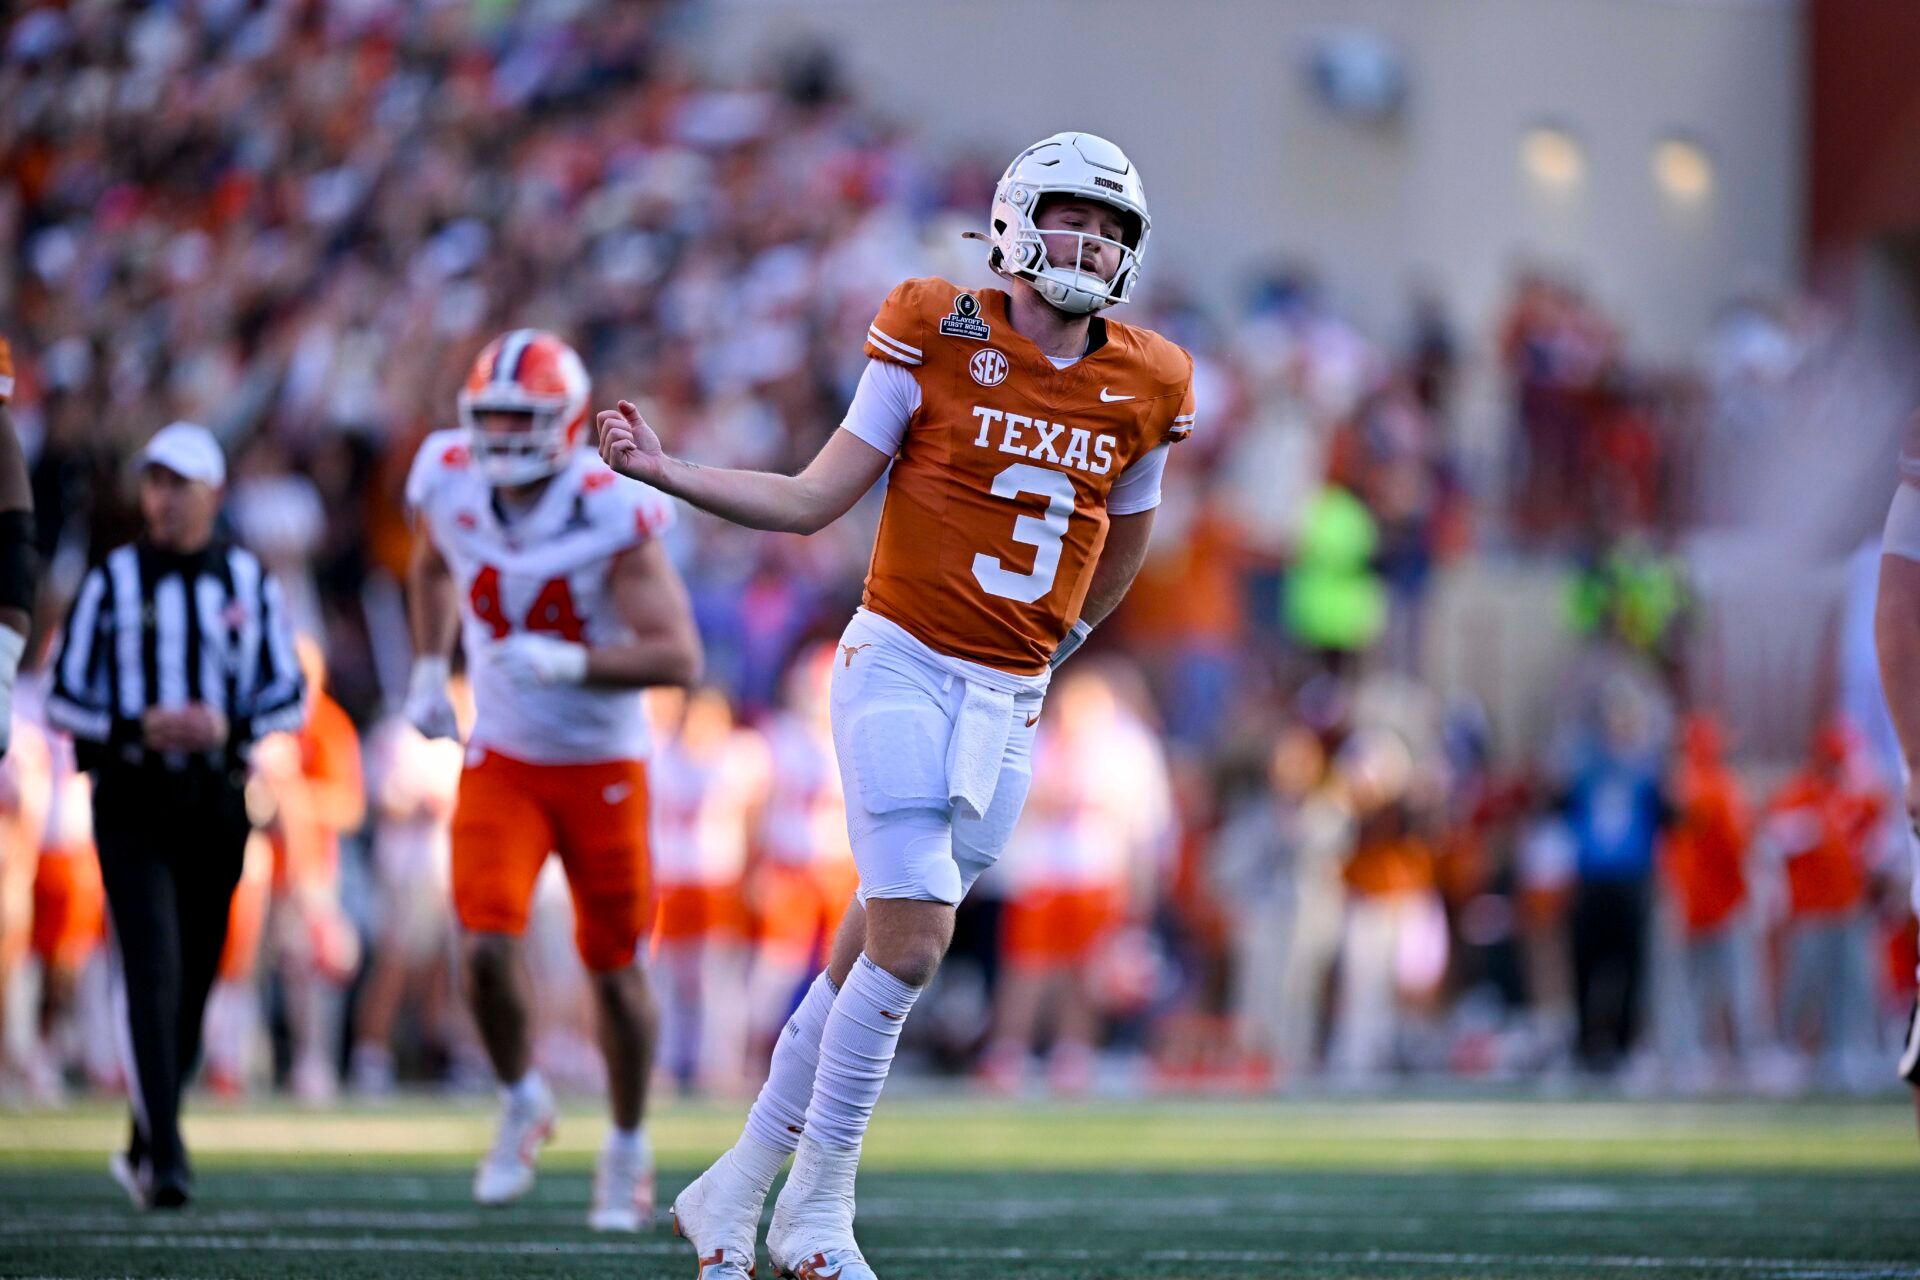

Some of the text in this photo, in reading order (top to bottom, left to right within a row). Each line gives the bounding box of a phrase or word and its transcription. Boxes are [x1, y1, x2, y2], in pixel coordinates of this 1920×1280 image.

[1094, 176, 1123, 193] HORNS
[943, 320, 964, 328] FIRST
[964, 324, 988, 333] ROUND
[951, 315, 981, 325] PLAYOFF
[973, 351, 1005, 384] SEC
[972, 405, 1116, 475] TEXAS
[971, 462, 1076, 604] 3
[470, 564, 590, 648] 44
